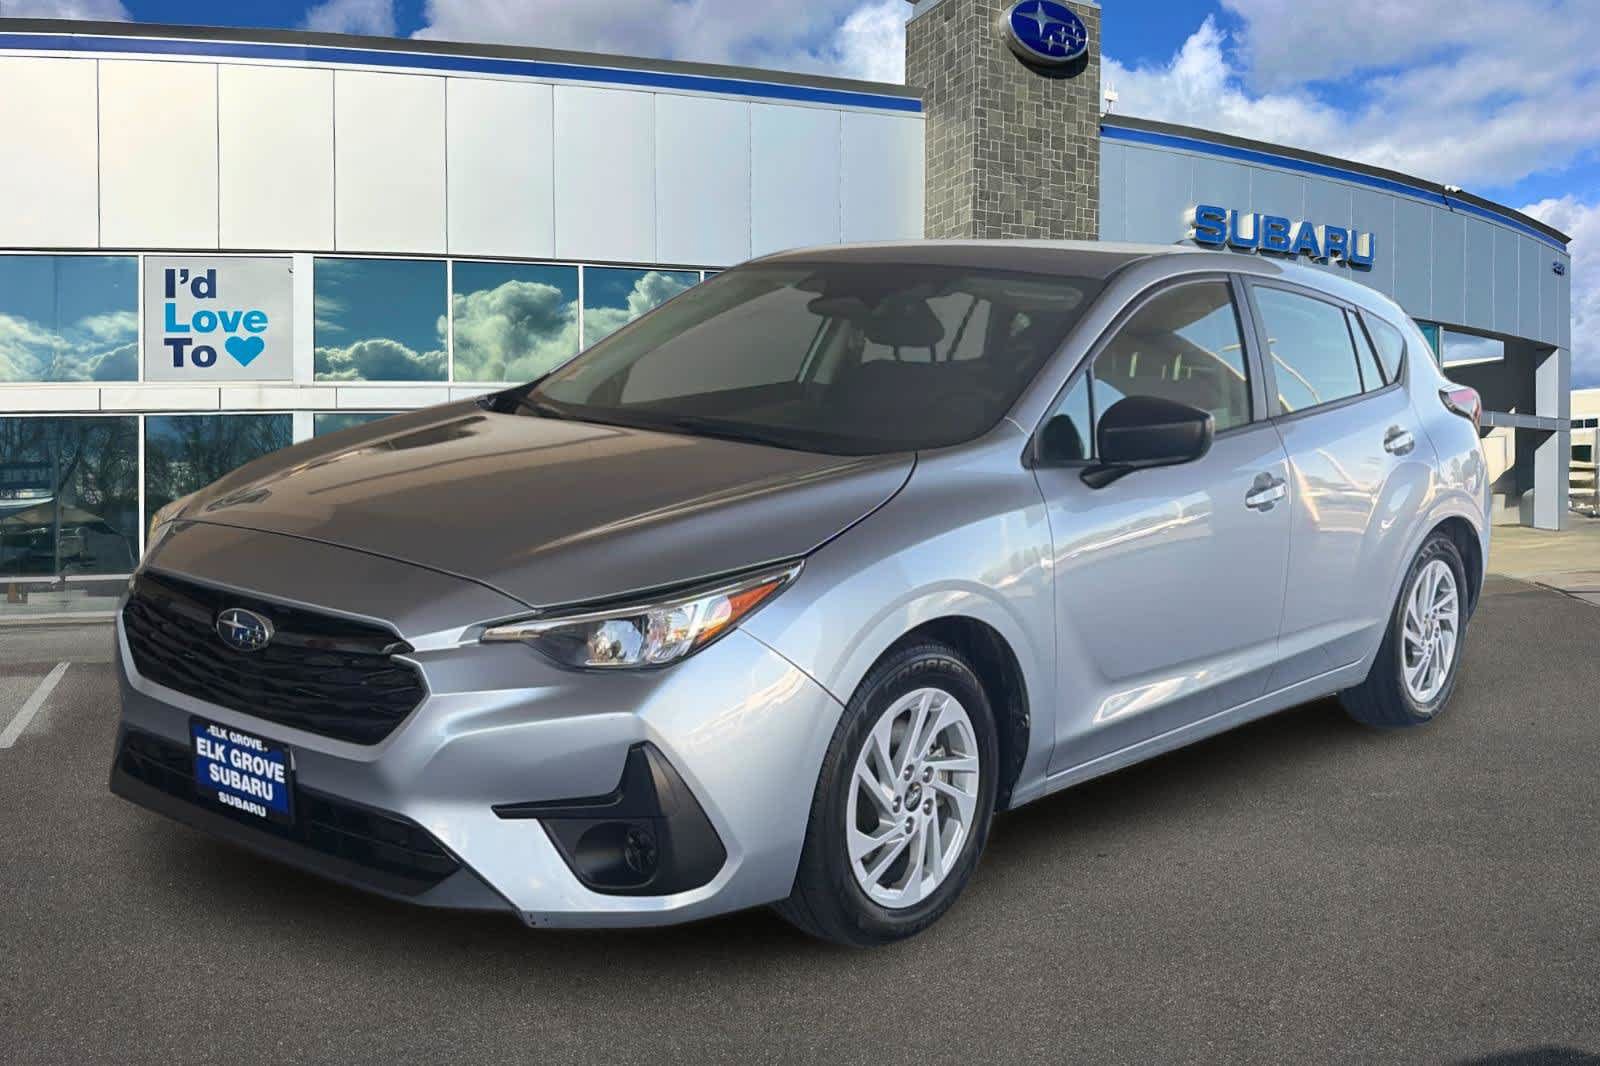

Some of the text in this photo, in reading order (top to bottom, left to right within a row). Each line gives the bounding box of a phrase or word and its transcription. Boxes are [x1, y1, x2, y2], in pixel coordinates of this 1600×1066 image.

[1191, 204, 1376, 269] SUBARU
[164, 268, 217, 299] I’d
[165, 302, 269, 334] Love
[163, 337, 218, 368] To
[209, 725, 229, 741] ELK
[196, 736, 285, 784] ELK GROVE
[208, 763, 274, 801] SUBARU
[218, 791, 267, 817] SUBARU
